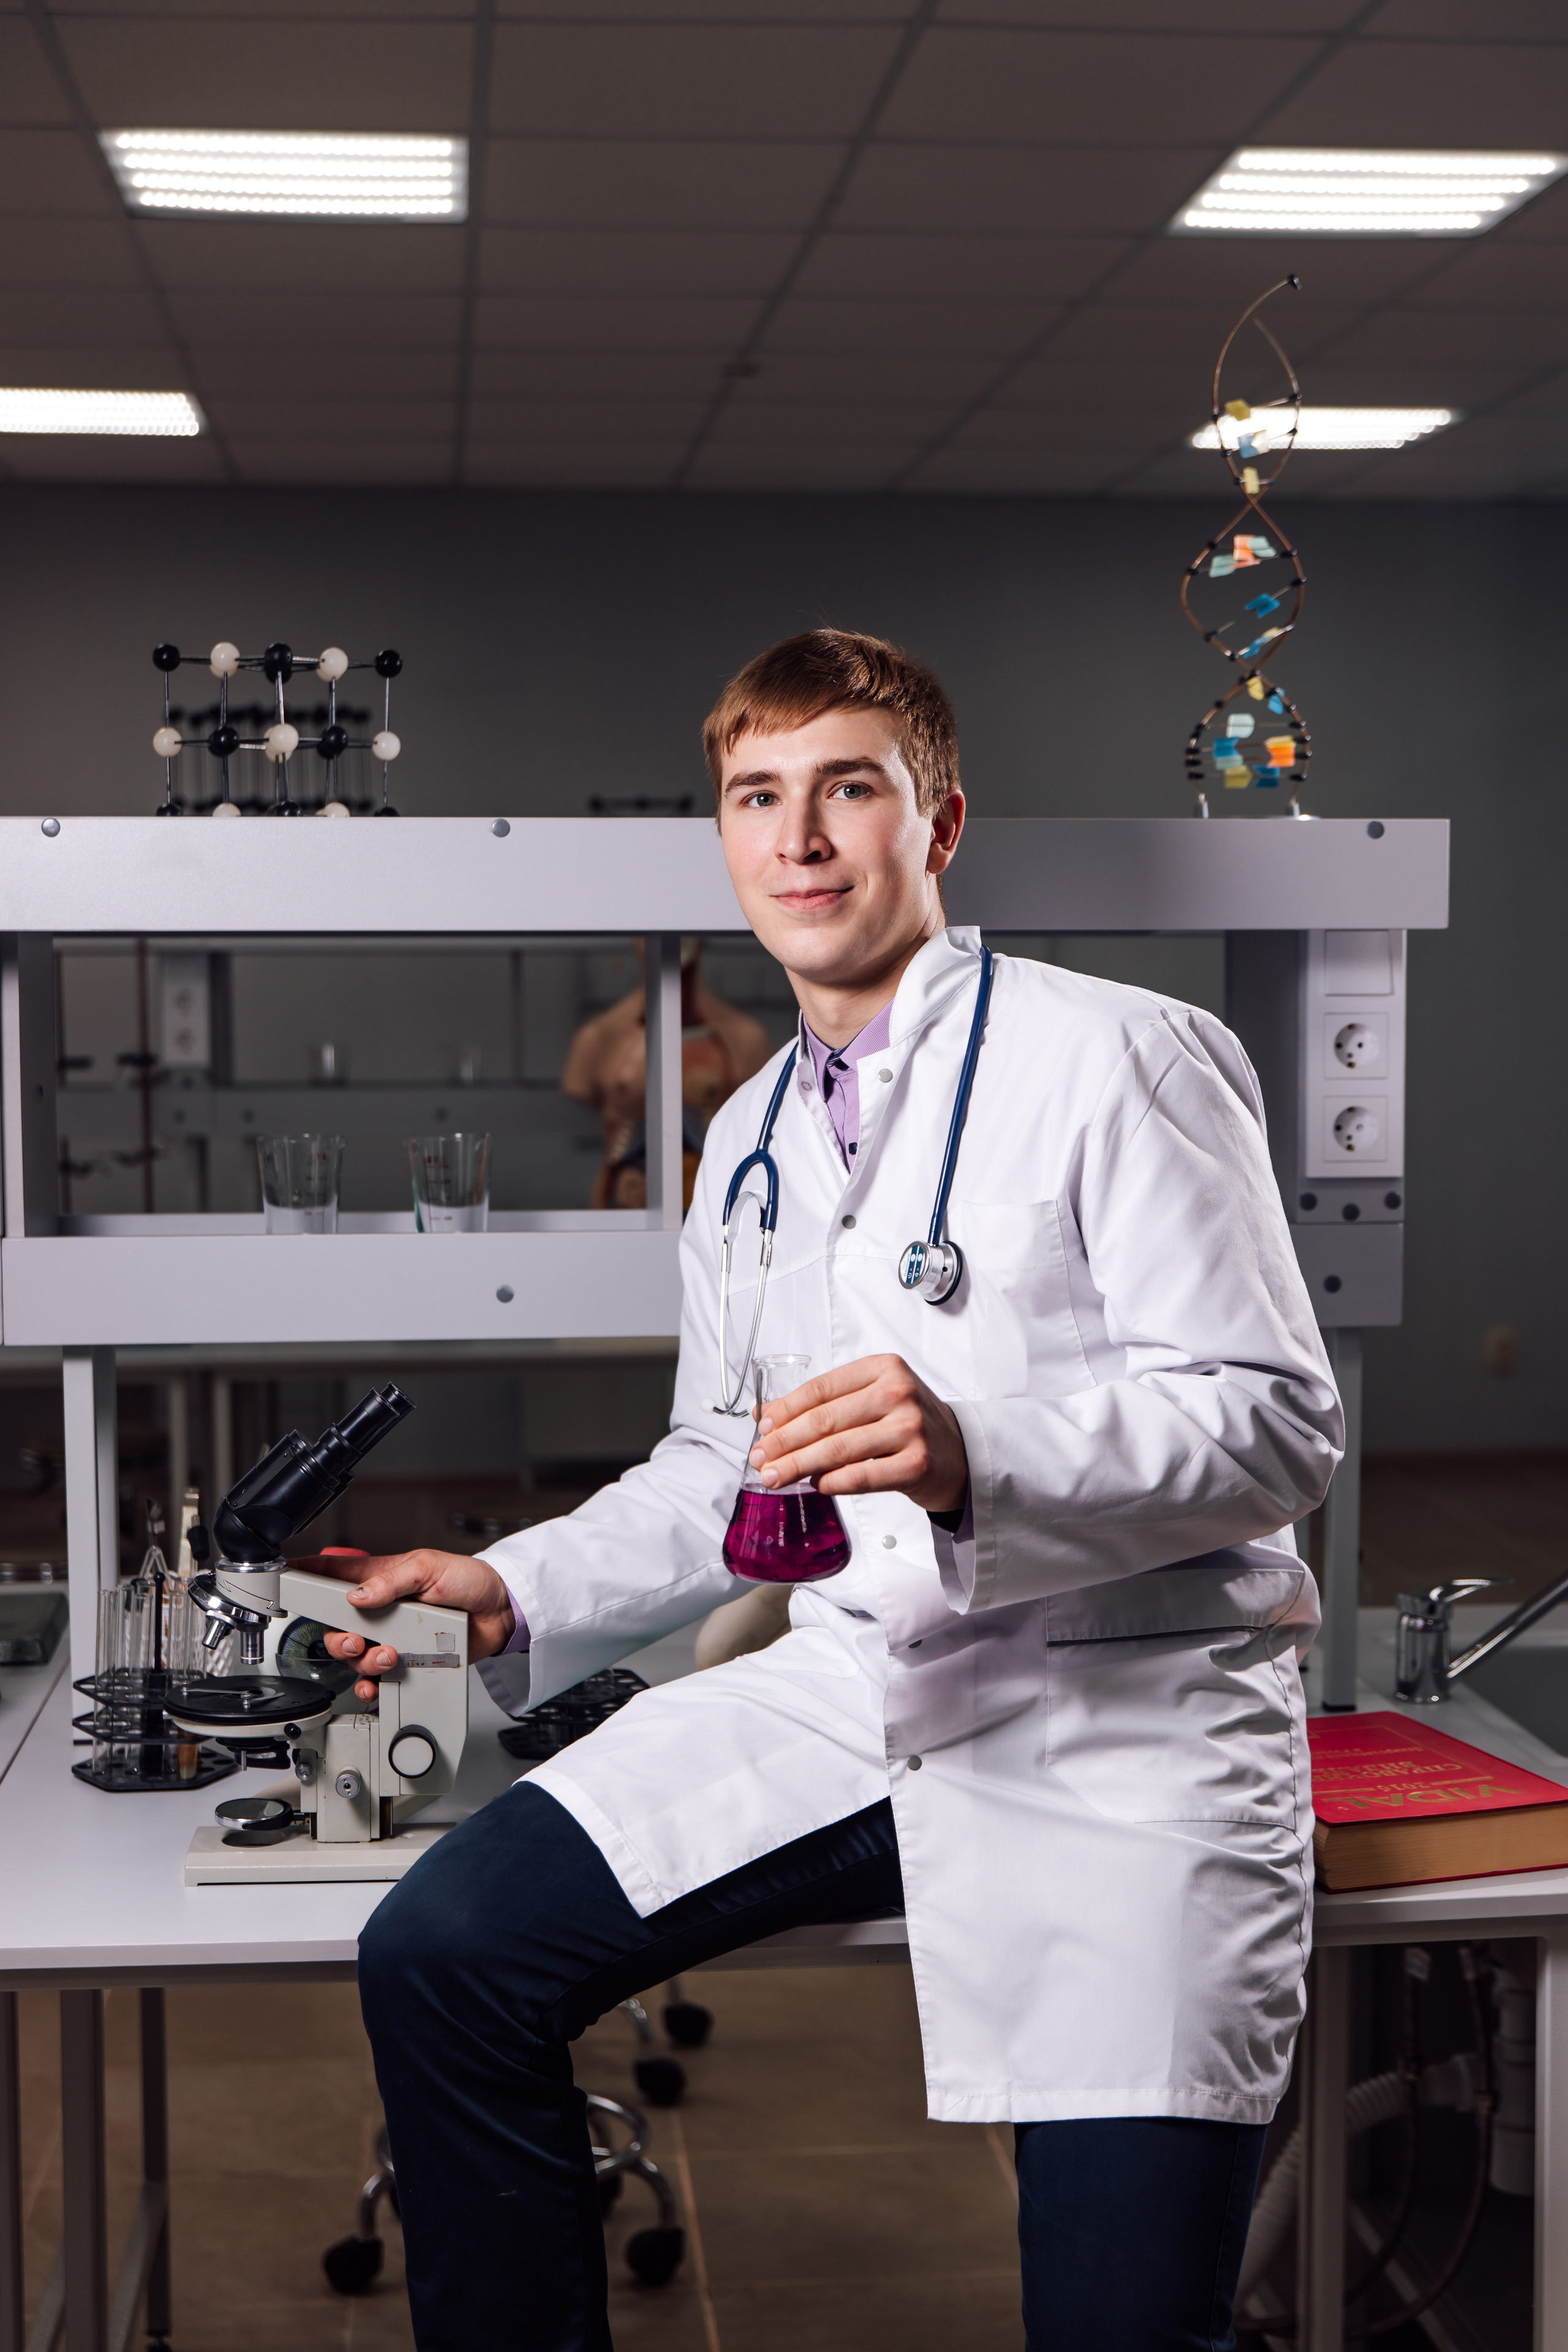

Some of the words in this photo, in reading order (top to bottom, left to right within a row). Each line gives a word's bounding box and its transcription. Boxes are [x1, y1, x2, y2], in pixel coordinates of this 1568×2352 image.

[1312, 1763, 1463, 1782] СПРАВОЧНИ
[1376, 1781, 1430, 1792] 2016
[1321, 1784, 1525, 1809] VIDAL
